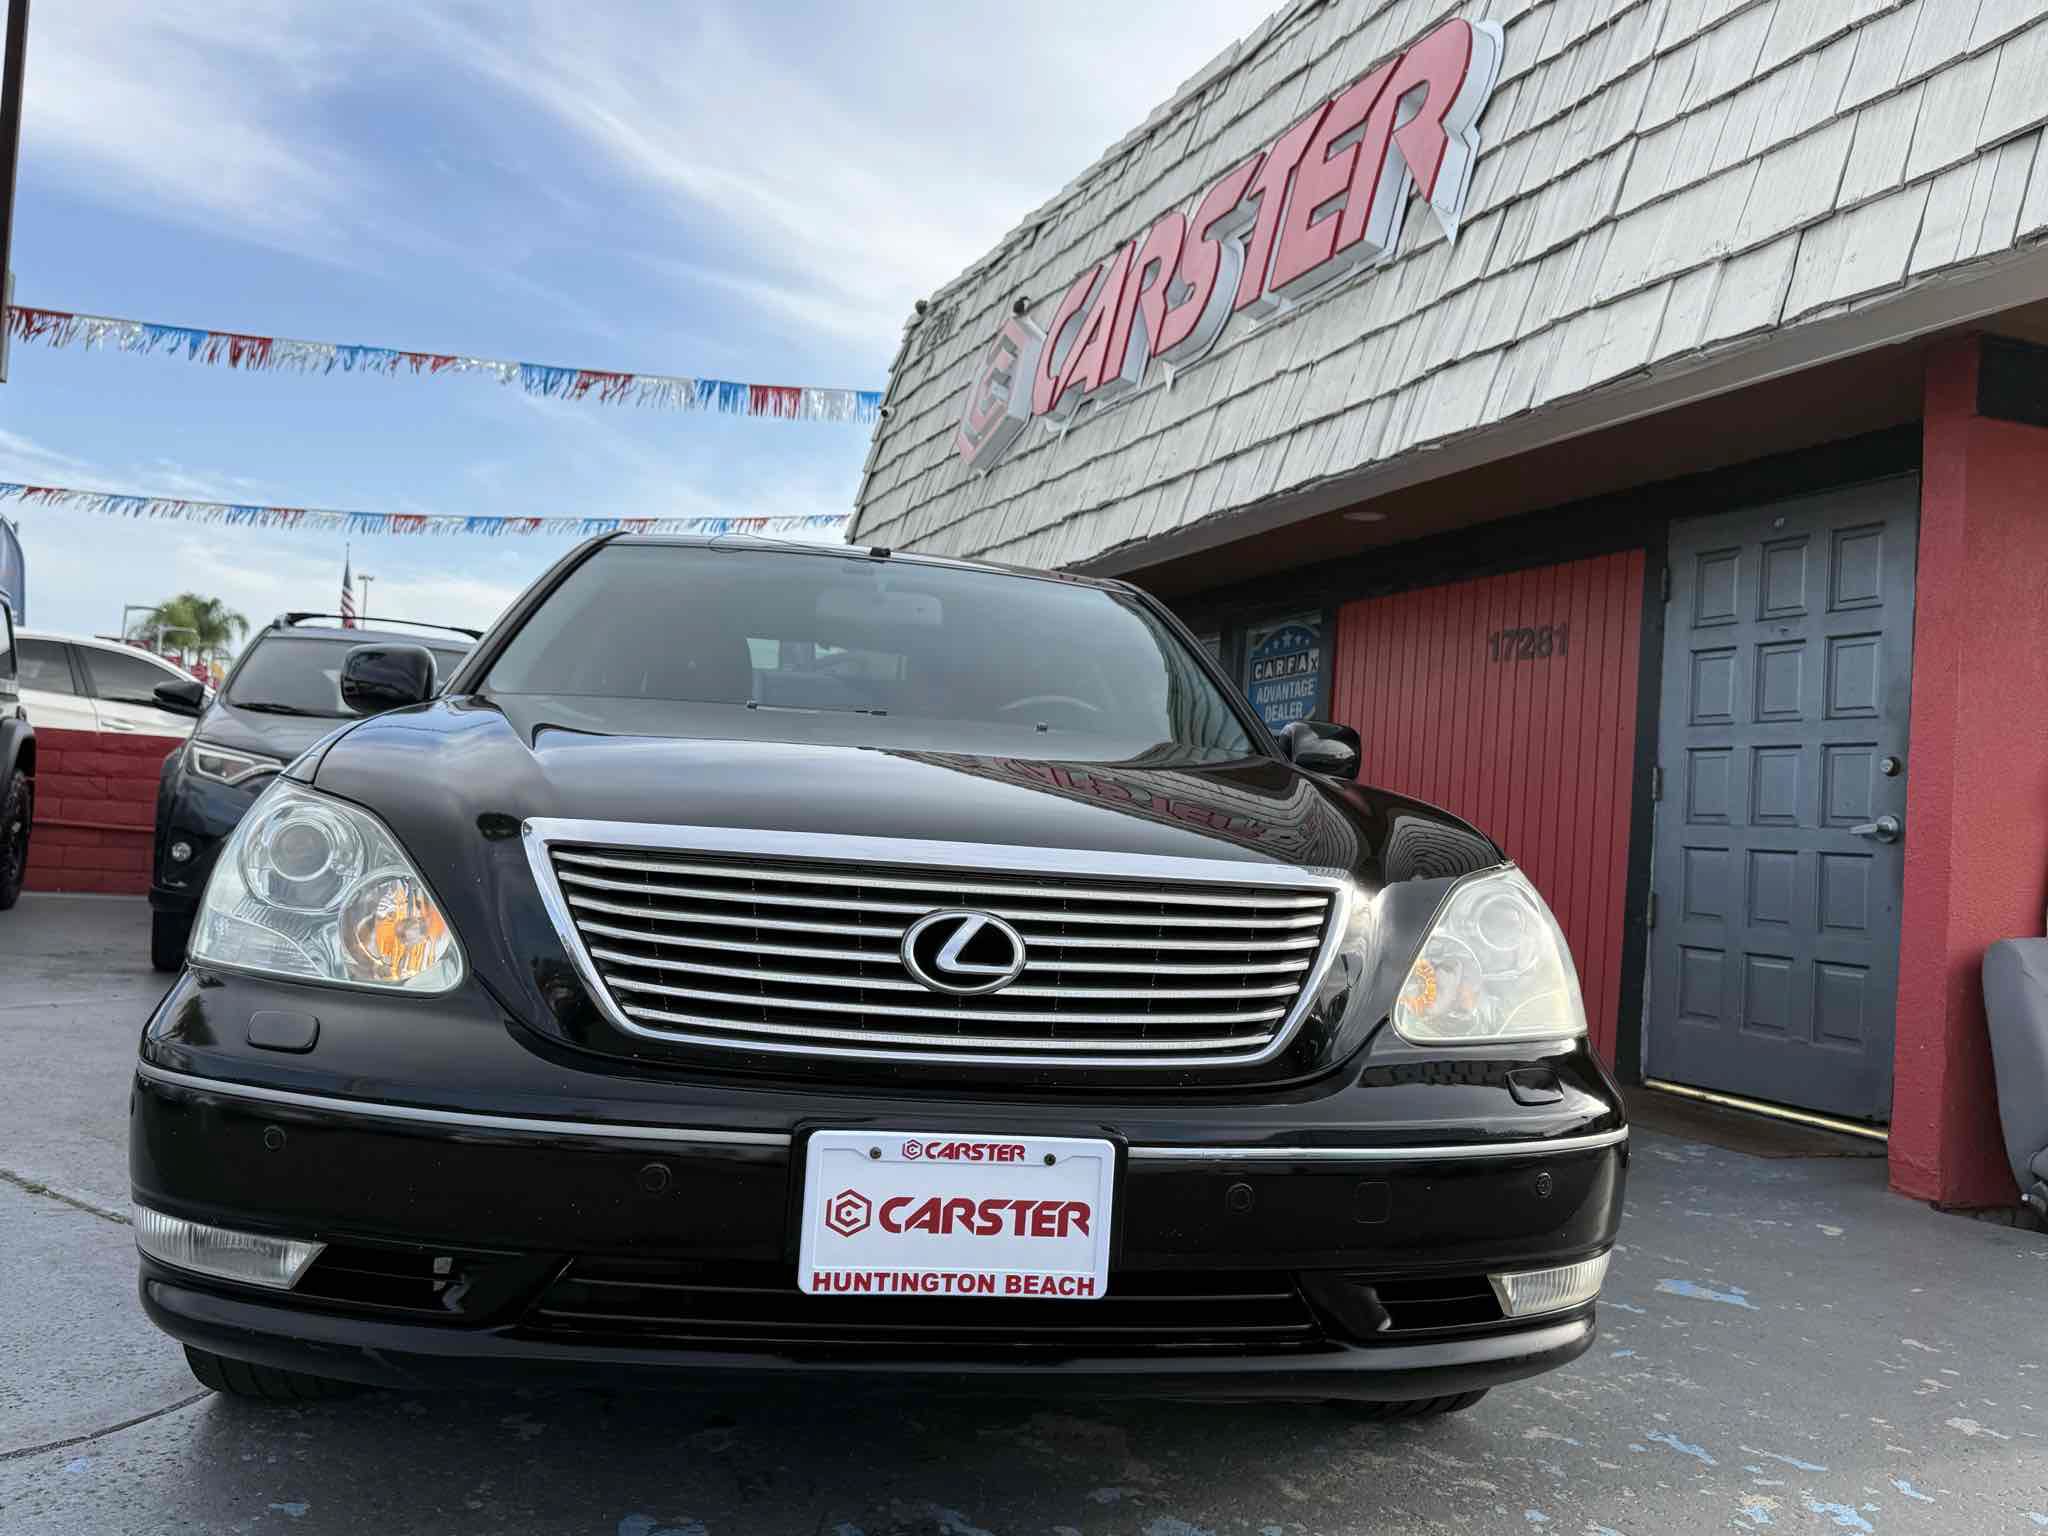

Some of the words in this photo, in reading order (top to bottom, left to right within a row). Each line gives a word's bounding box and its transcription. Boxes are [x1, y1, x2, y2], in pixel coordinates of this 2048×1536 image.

[1032, 19, 1490, 416] CARSTER
[1488, 622, 1568, 661] 17281
[1254, 649, 1320, 680] CARFAX
[1256, 680, 1314, 704] ADVANTAGE
[1264, 702, 1303, 722] DEALER
[925, 1142, 1025, 1162] CARSTER
[879, 1197, 1091, 1238] CARSTER
[812, 1271, 995, 1293] HUNTINGTON
[1005, 1275, 1095, 1296] BEACH
